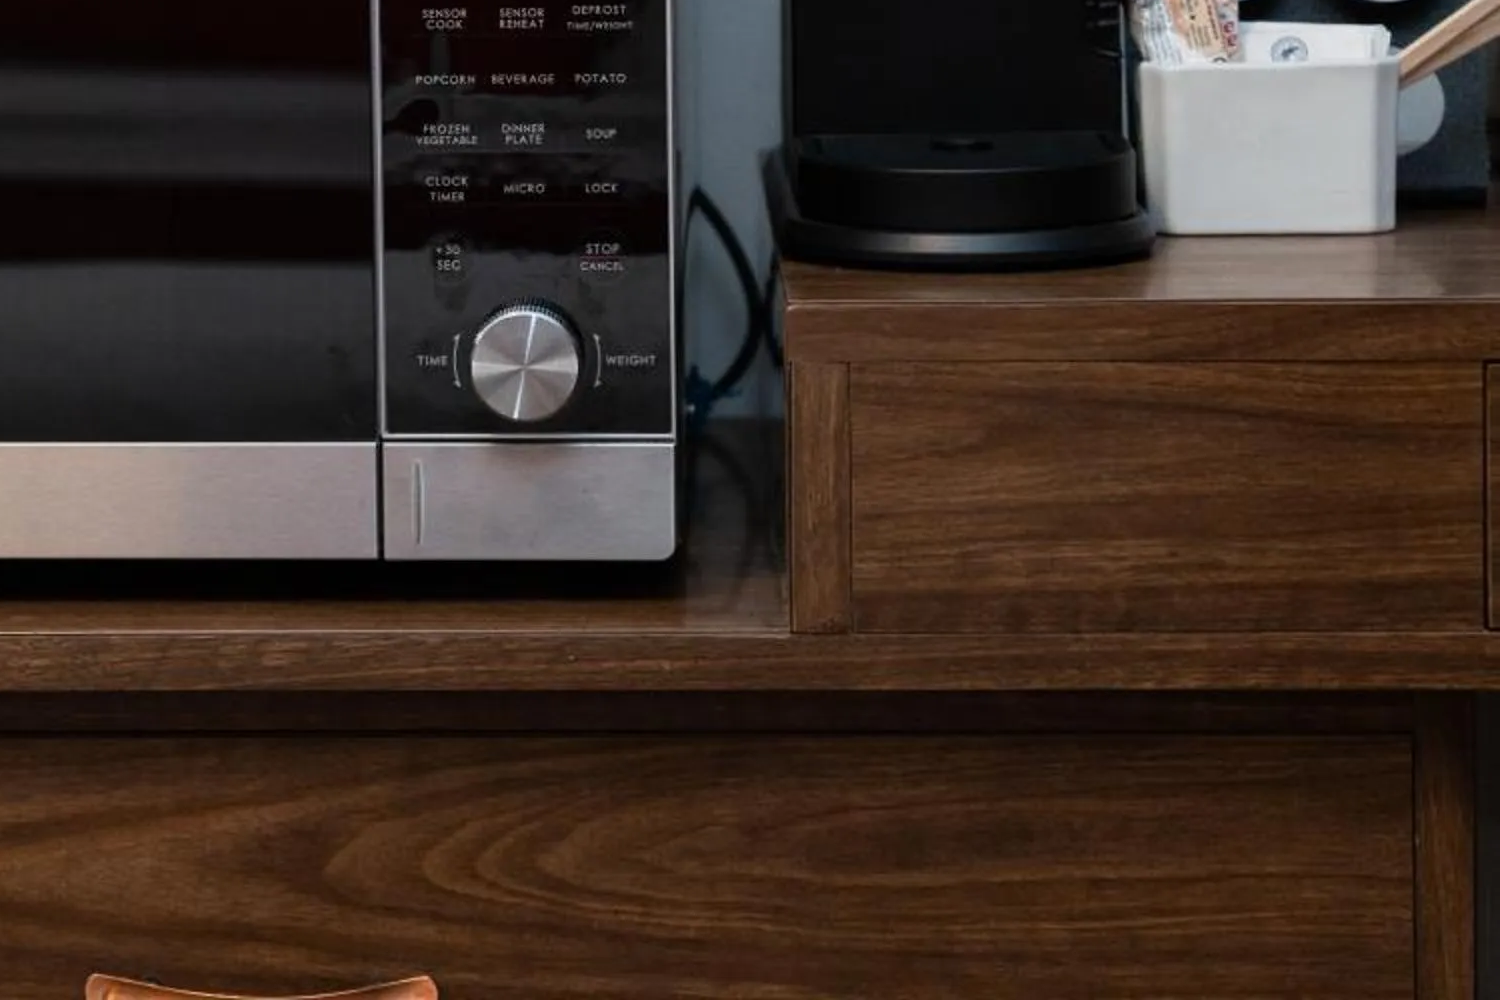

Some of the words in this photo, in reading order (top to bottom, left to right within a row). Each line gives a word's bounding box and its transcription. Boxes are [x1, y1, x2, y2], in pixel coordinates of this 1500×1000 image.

[421, 8, 468, 19] SENSOR
[499, 7, 545, 18] SENSOR
[572, 4, 627, 16] DEFROST
[426, 19, 463, 29] COOK
[499, 18, 545, 30] REHEAT
[415, 75, 476, 86] POPCORN
[491, 73, 555, 85] BEVERAGE
[574, 73, 628, 84] POTATO
[423, 124, 471, 135] FROZEN
[501, 123, 546, 134] DINNER
[586, 128, 617, 140] SOUP
[415, 135, 478, 145] VEGETABLE
[505, 134, 543, 145] PLATE
[425, 176, 469, 188] CLOCK
[503, 183, 546, 194] MICRO
[585, 183, 620, 193] LOCK
[430, 191, 465, 202] TIMER
[585, 243, 621, 255] STOP
[580, 261, 624, 272] CANCEL
[417, 355, 448, 367] TIME
[606, 354, 657, 366] WEIGHT
